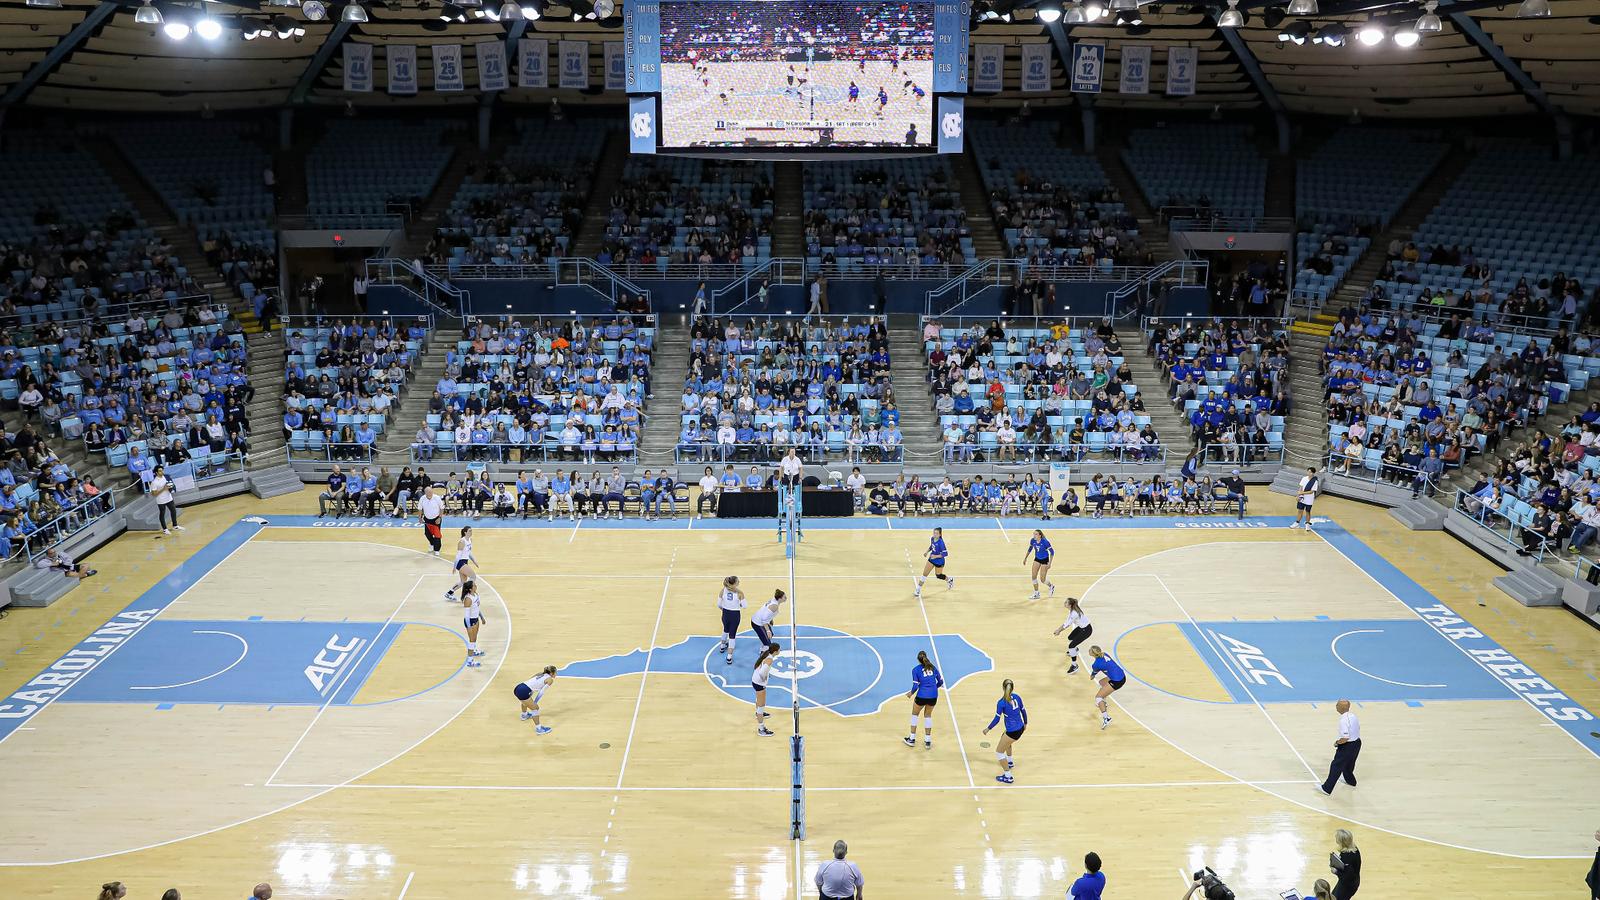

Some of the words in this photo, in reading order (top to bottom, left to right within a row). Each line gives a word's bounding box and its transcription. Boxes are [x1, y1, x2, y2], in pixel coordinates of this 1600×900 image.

[639, 35, 652, 43] PLY
[939, 35, 952, 43] PLY
[440, 62, 455, 75] 25
[566, 58, 581, 71] 34
[938, 64, 952, 72] FLS
[1029, 62, 1043, 75] 42
[1081, 63, 1094, 75] 12
[1128, 64, 1142, 76] 20
[1178, 65, 1186, 77] 2
[727, 592, 734, 601] 9
[1414, 604, 1484, 640] TAR
[0, 608, 159, 719] CAROLINA
[304, 634, 360, 692] ACC
[1217, 633, 1294, 689] ACC
[1467, 649, 1594, 721] HEELS
